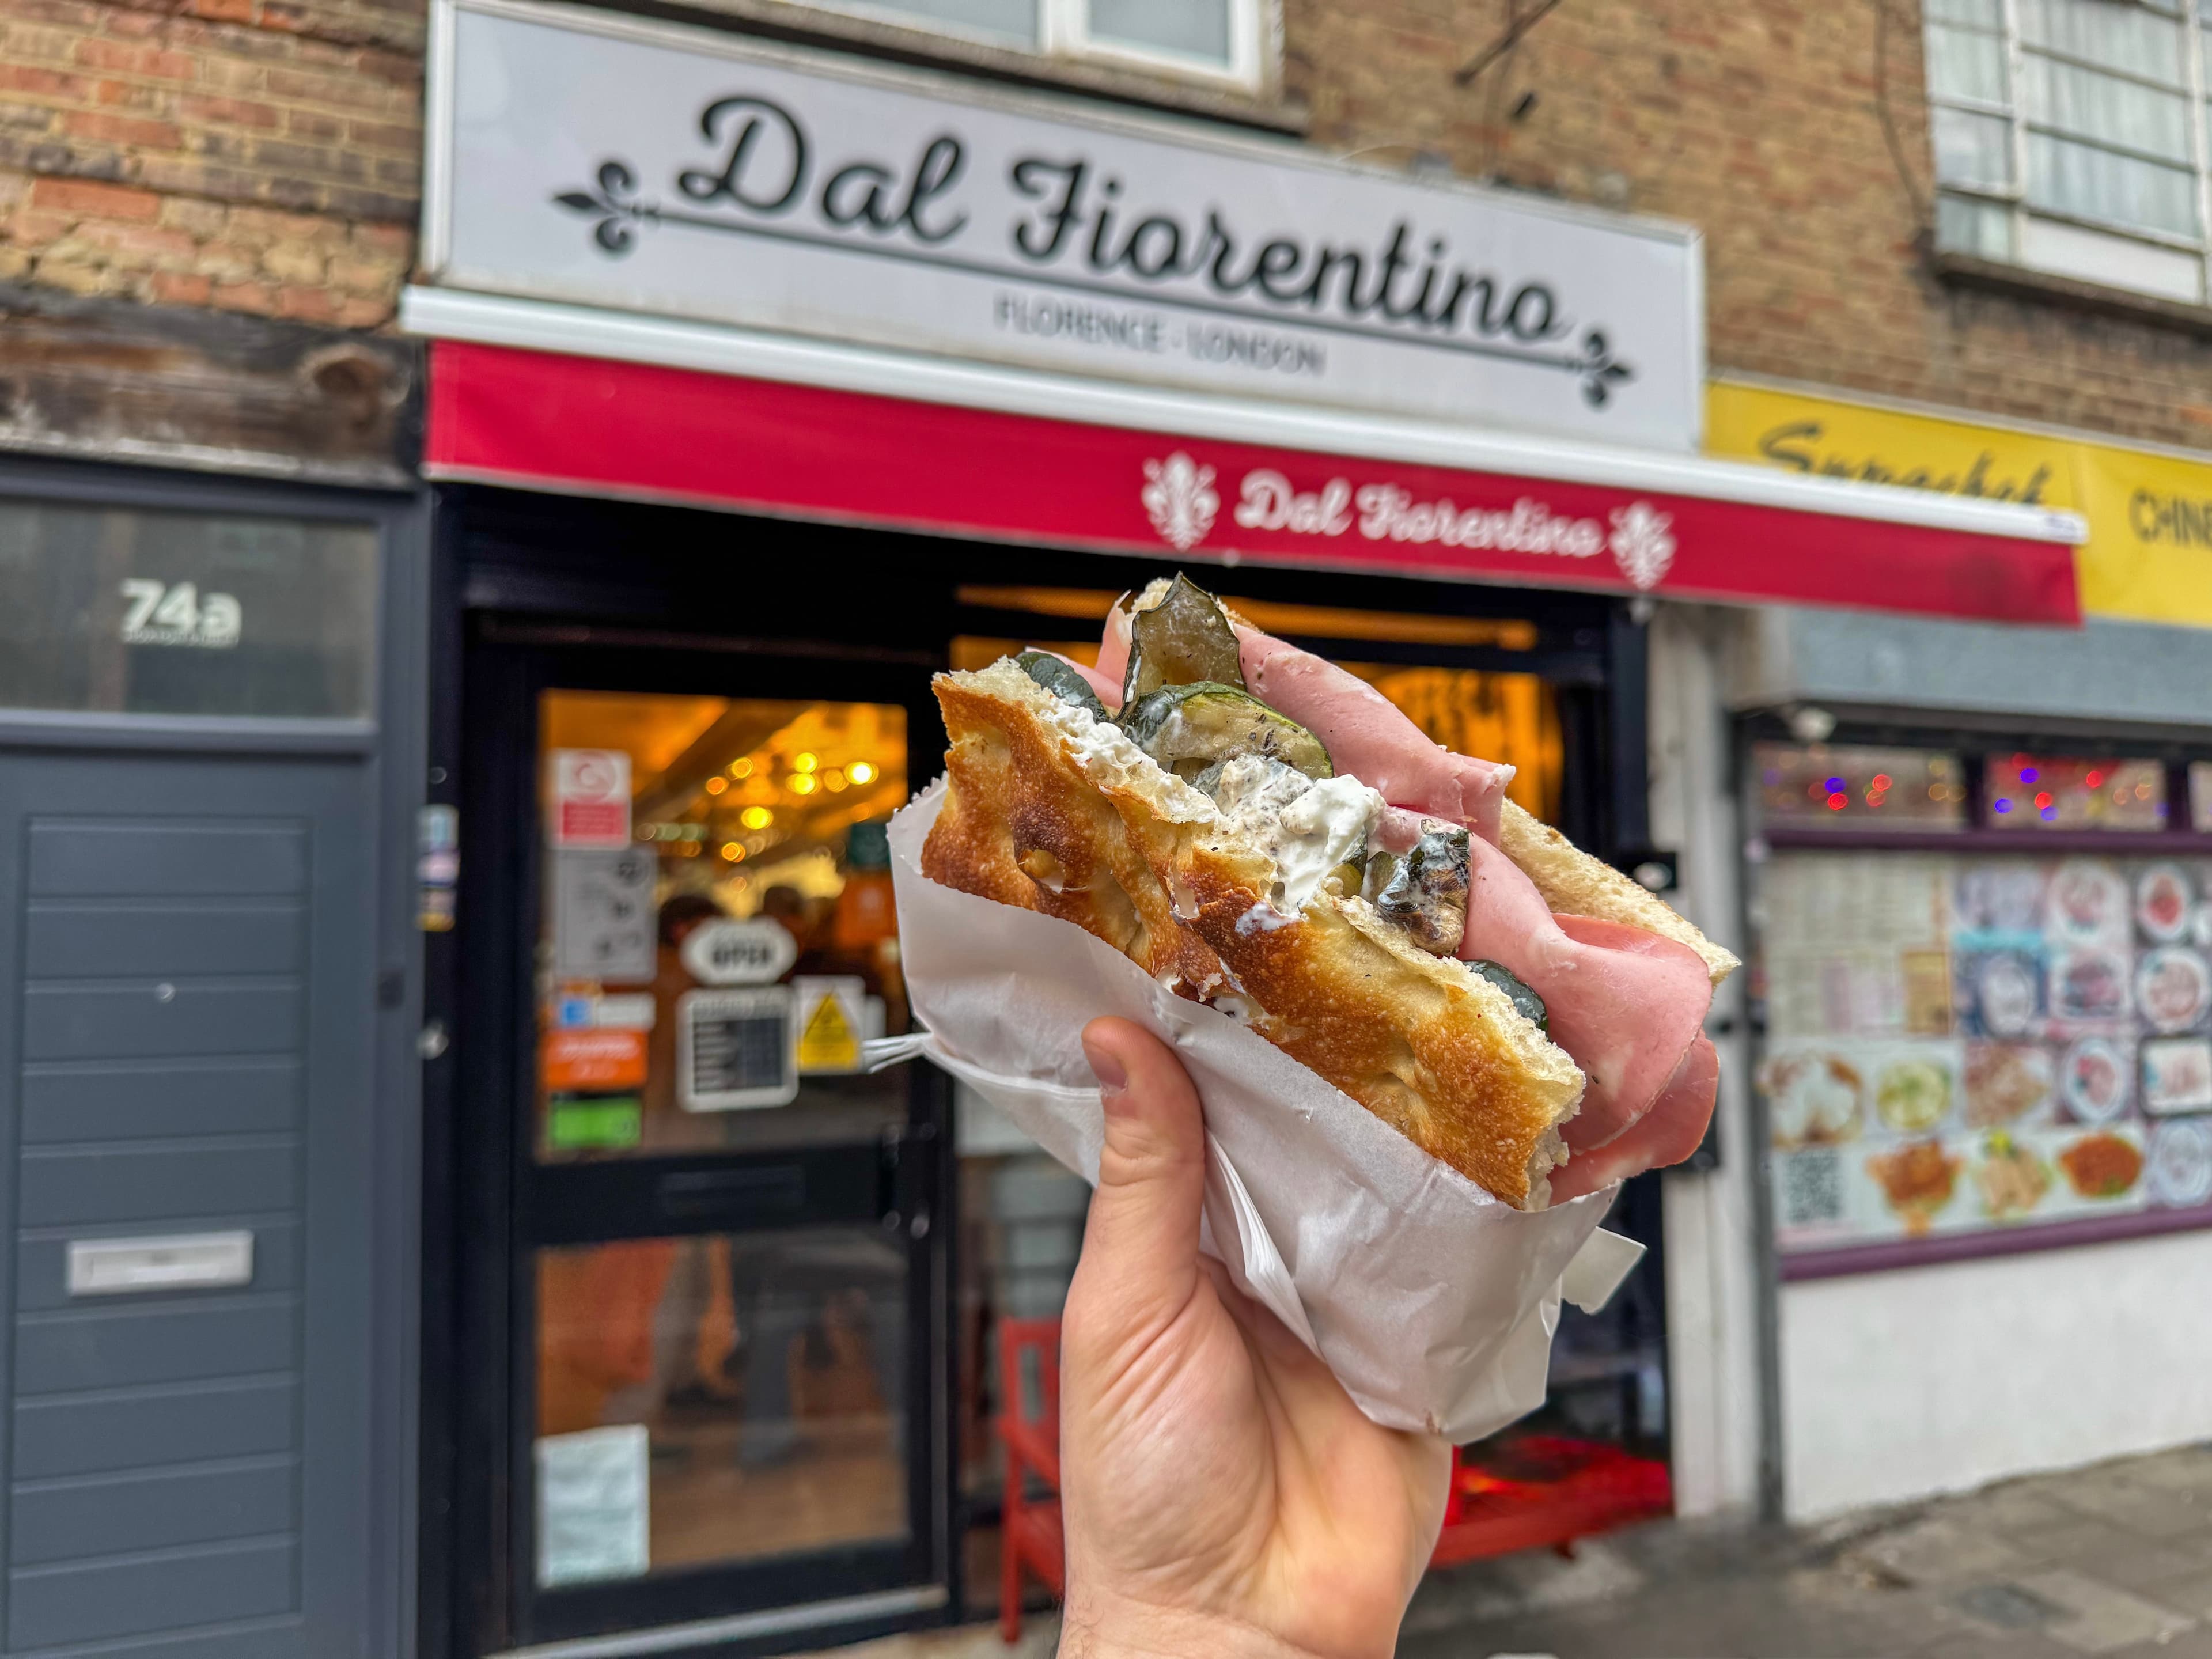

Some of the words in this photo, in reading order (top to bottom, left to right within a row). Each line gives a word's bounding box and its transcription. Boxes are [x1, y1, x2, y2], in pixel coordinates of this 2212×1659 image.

[675, 93, 965, 243] Dal
[1008, 154, 1570, 342] Fiorentino
[993, 293, 1161, 353] FLORENCE
[1187, 321, 1324, 376] LONDON
[1234, 468, 1354, 537] Dal
[1356, 483, 1612, 559] Fiorentino
[119, 578, 242, 638] 74a
